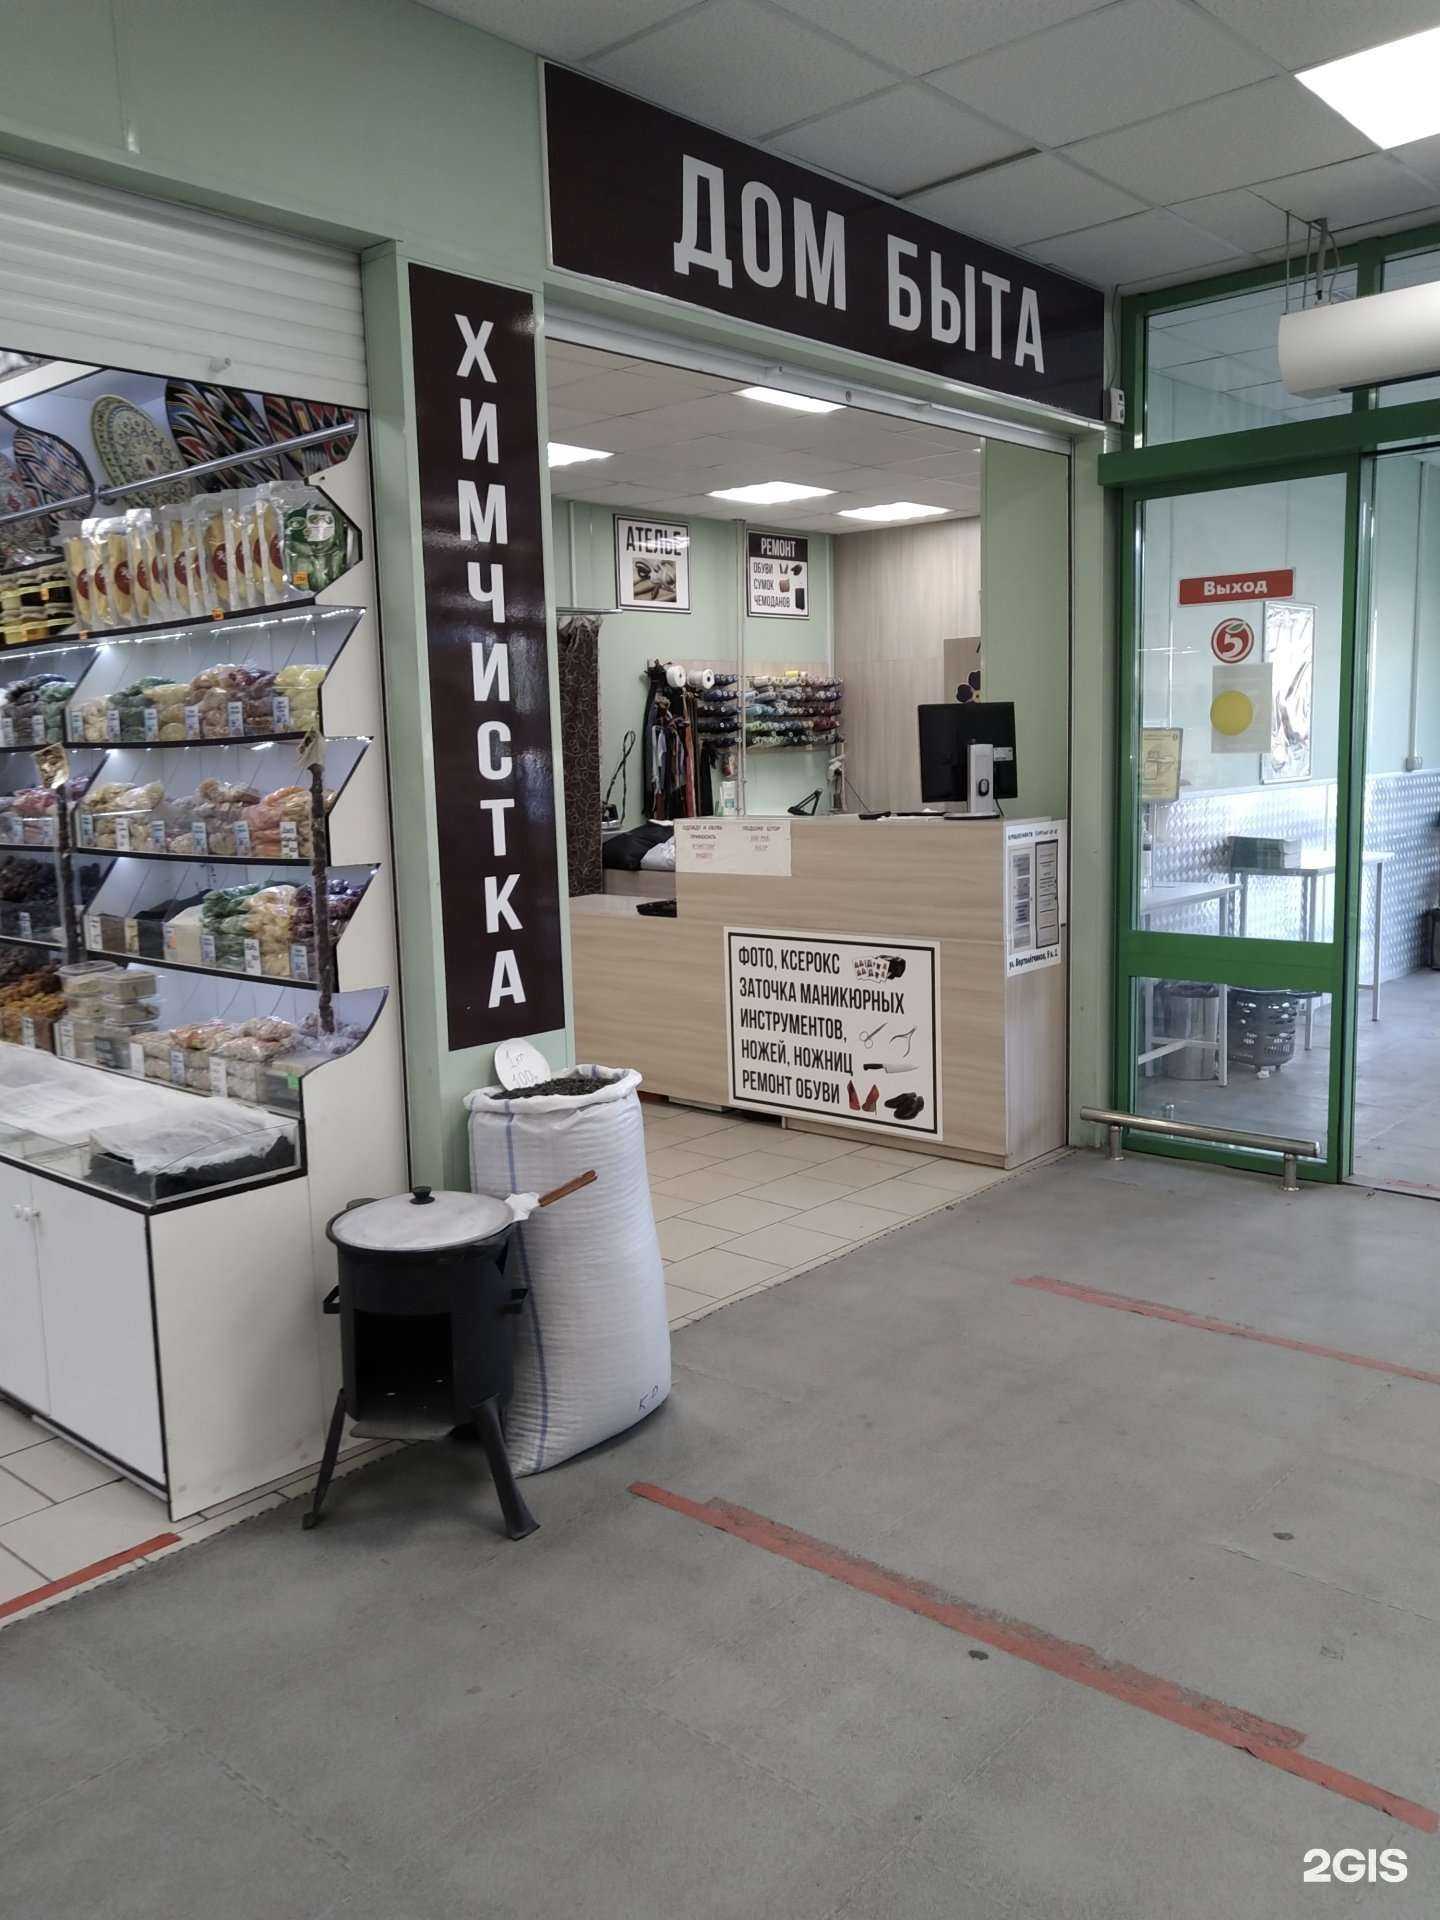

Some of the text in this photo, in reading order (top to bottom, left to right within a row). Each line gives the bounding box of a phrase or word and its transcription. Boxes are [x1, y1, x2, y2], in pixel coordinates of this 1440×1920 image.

[673, 154, 1045, 374] ДОМ БЫТА
[626, 526, 682, 556] АТЕЛЬЕ
[760, 537, 796, 557] РЕМОНТ
[753, 561, 774, 574] ОБУВИ
[753, 577, 775, 591] СУМОК
[1203, 579, 1268, 596] Выход
[754, 594, 791, 609] ЧЕМОДАНОВ
[454, 313, 527, 1009] ХИМЧИСТКА
[738, 946, 840, 974] ФОТО, КСЕРОКС
[739, 977, 905, 1014] ЗАТОЧКА МАНИКЮРНЫХ
[740, 1008, 847, 1043] ИНСТРУМЕНТОВ,
[741, 1039, 854, 1076] НОЖЕЙ, НОЖНИЦ
[742, 1070, 840, 1104] РЕМОНТ ОБУВИ
